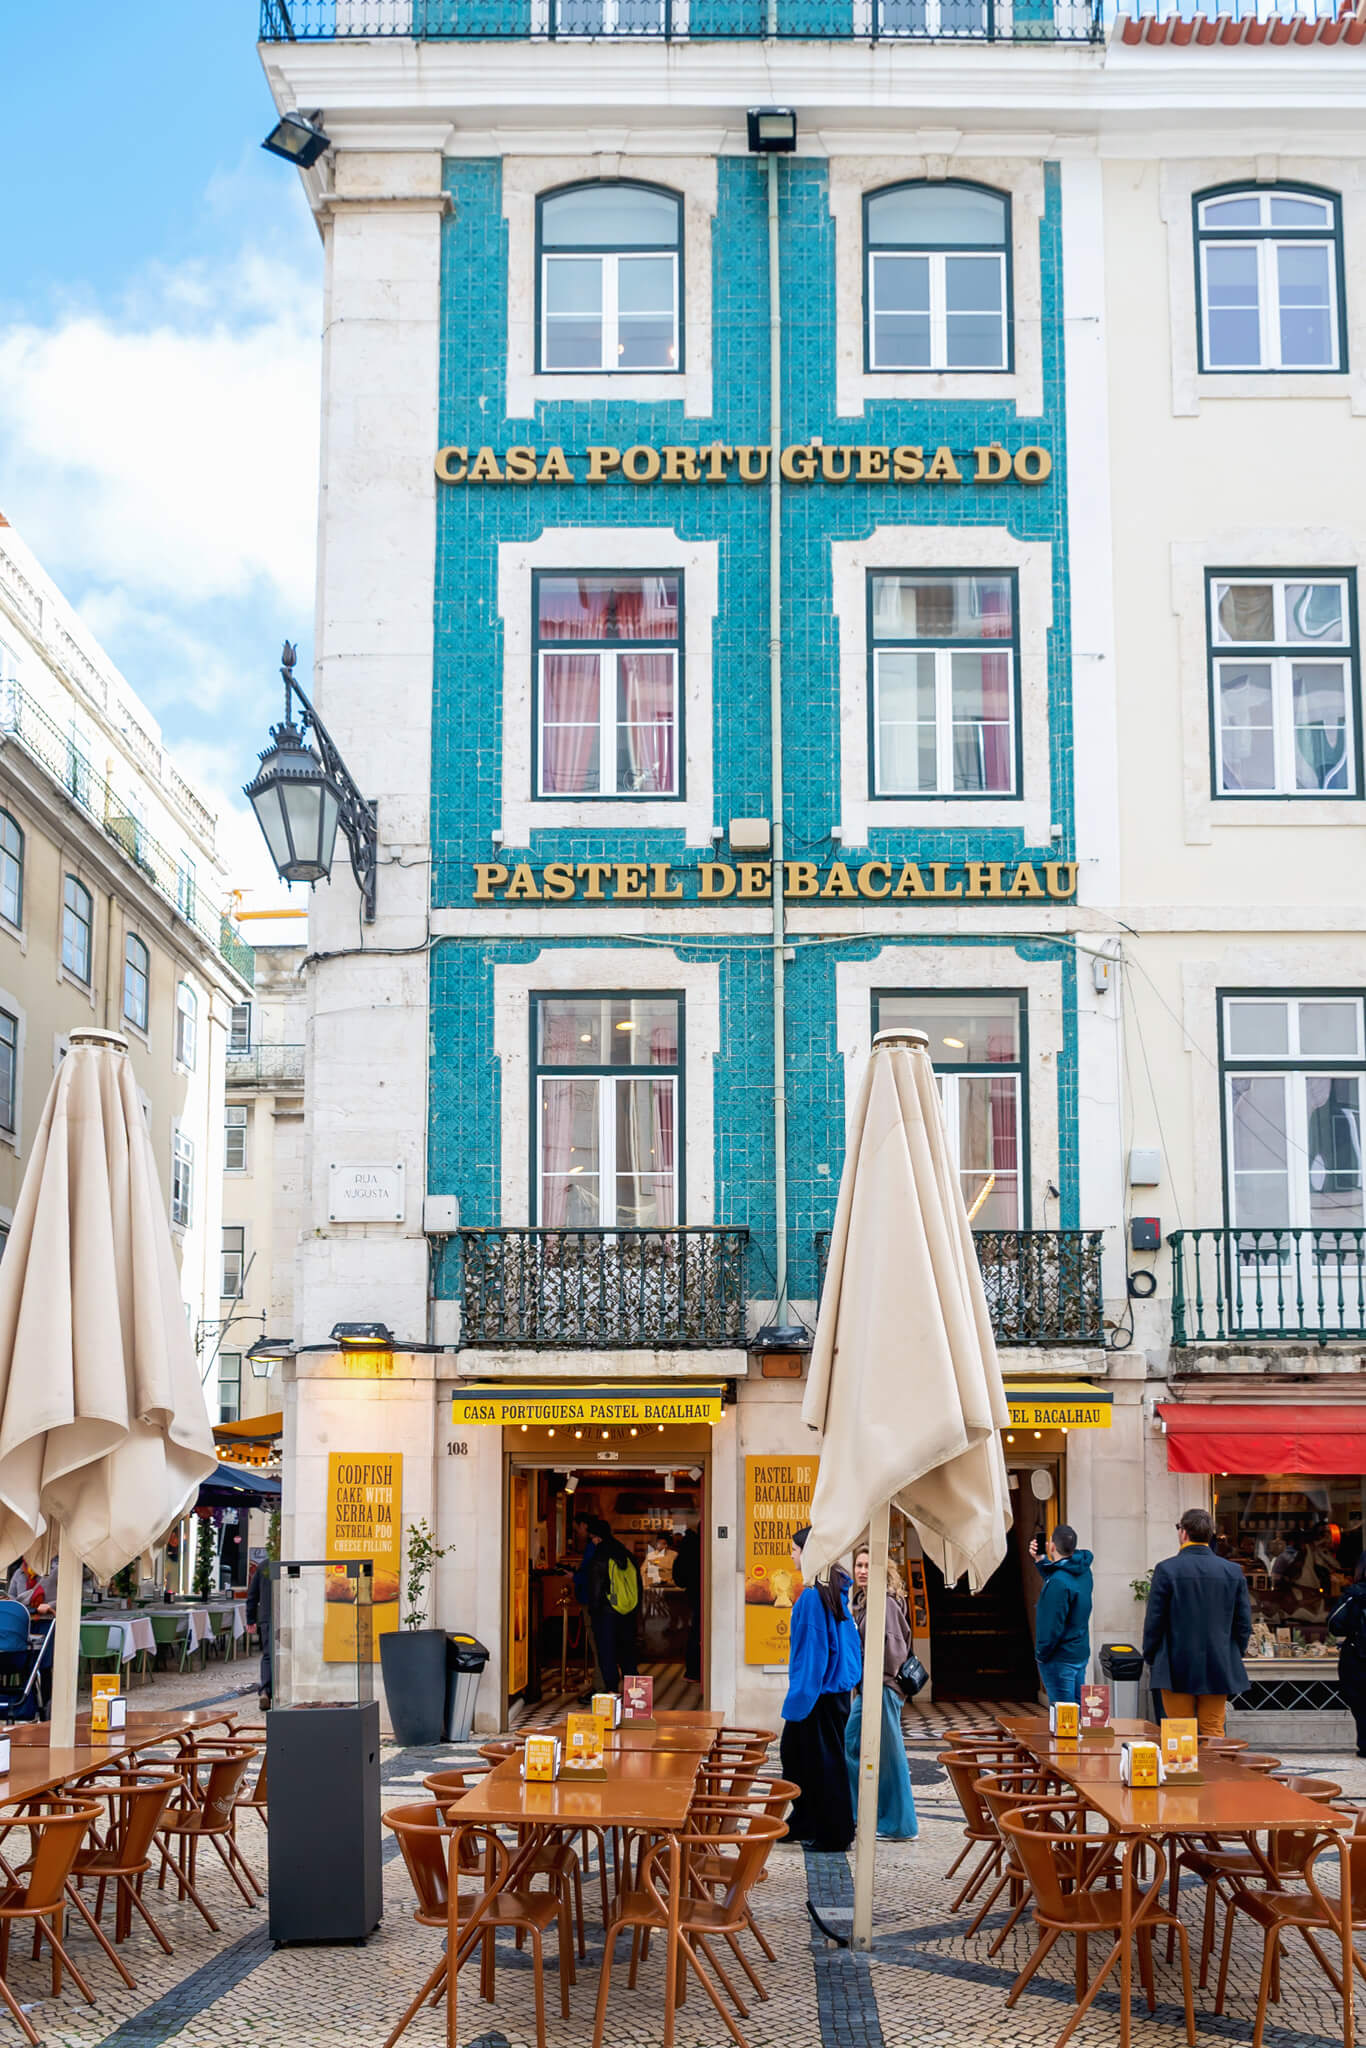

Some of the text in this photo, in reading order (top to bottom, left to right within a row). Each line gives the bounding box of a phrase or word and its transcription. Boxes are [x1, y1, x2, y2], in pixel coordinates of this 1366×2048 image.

[435, 446, 1052, 485] CASA PORTUGUESA DO
[473, 861, 1079, 900] PASTEL DE BACALHAU
[354, 1174, 378, 1184] RUA
[345, 1188, 391, 1199] AUGUSTA
[464, 1404, 711, 1419] CASA PORTUGUESA PASTEL BACALHAU
[1034, 1409, 1100, 1423] BACALHAU
[447, 1441, 468, 1456] 108
[337, 1465, 392, 1485] CODFISH
[754, 1466, 811, 1484] PASTEL DE
[336, 1487, 392, 1503] CAKE WITH
[755, 1485, 810, 1503] BACALHAU
[336, 1504, 392, 1522] SERRA DA
[753, 1504, 811, 1520] COM QUEIJO
[335, 1524, 392, 1539] ESTRELA PDO
[753, 1521, 792, 1540] SERRA
[334, 1540, 392, 1553] CHEESE FILLING
[753, 1541, 792, 1555] ESTRELA
